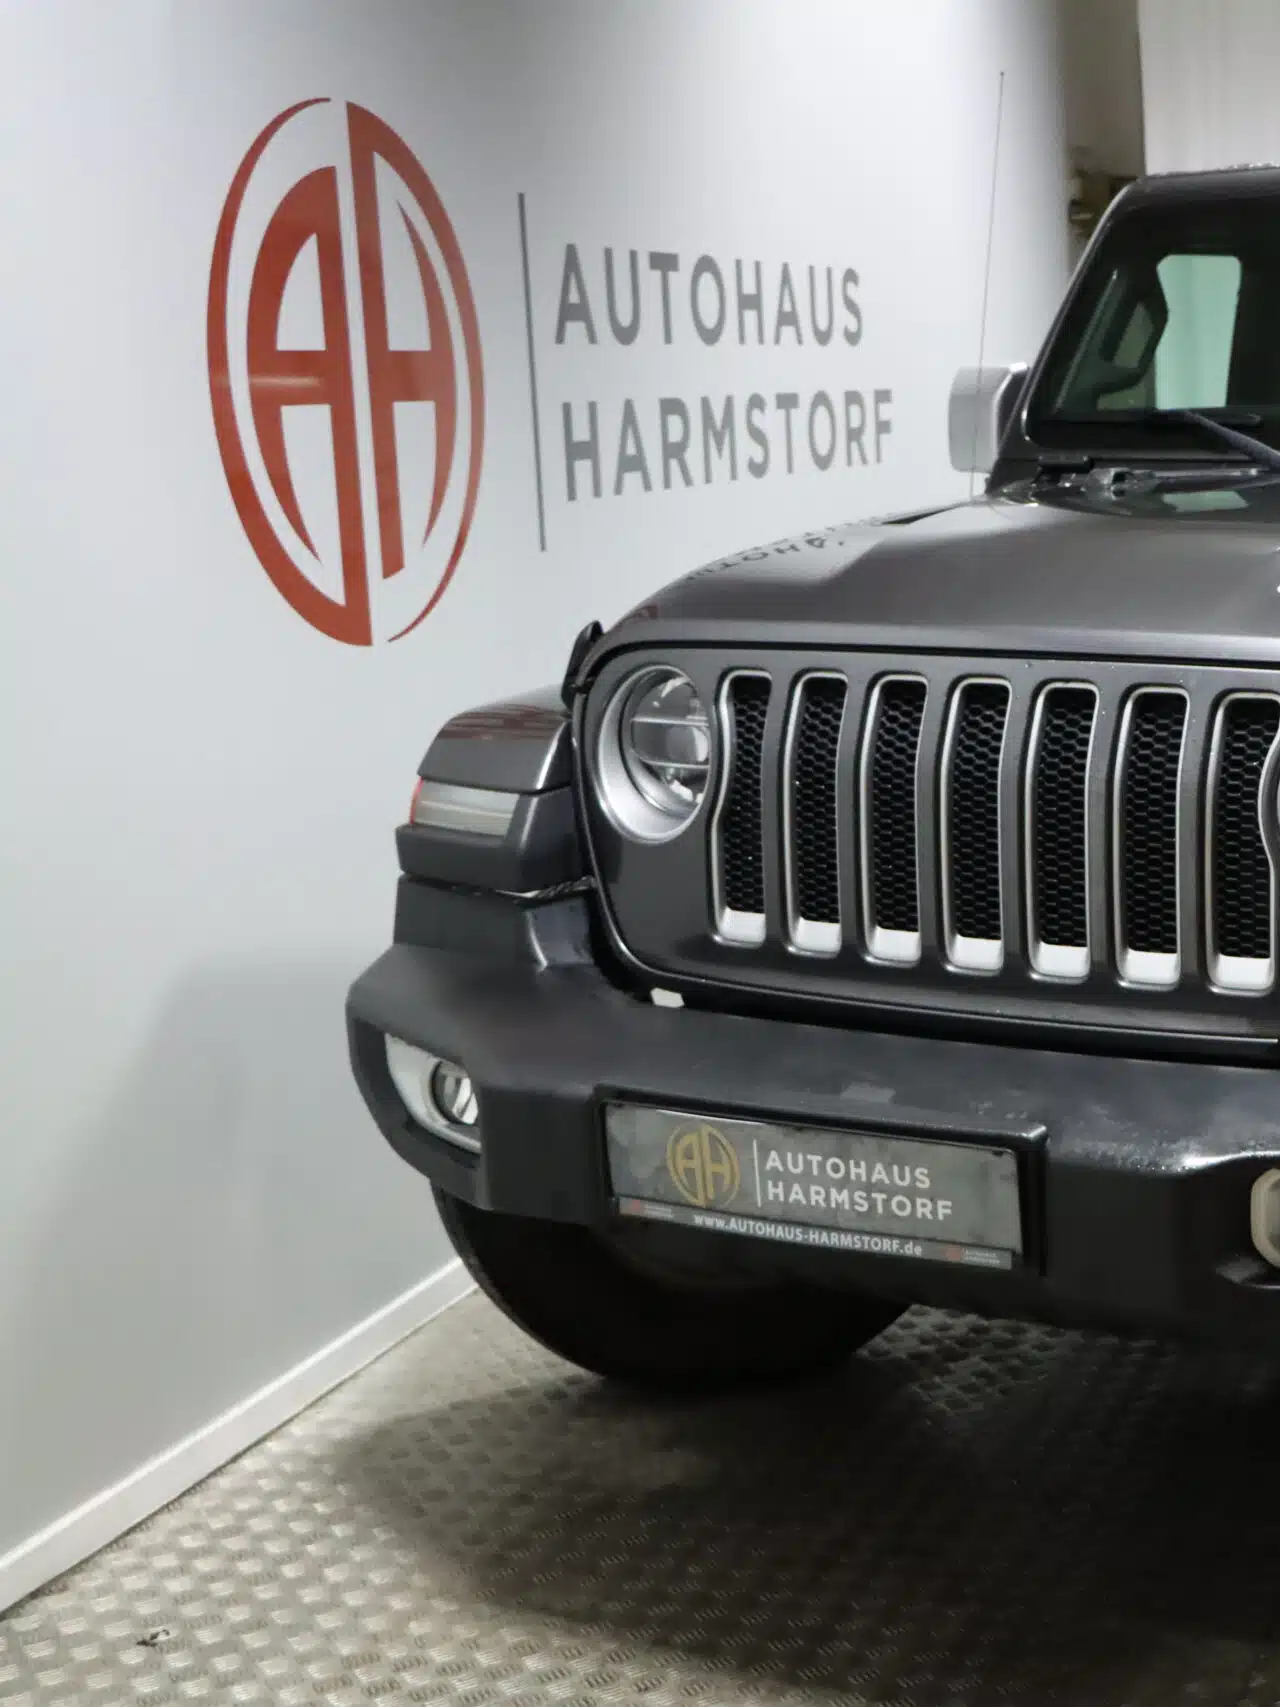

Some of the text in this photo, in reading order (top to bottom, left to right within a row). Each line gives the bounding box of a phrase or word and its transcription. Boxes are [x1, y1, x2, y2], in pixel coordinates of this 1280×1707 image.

[554, 243, 863, 347] AUTOHAUS
[561, 389, 894, 502] HARMSTORF
[765, 1150, 932, 1189] AUTOHAUS
[767, 1180, 953, 1221] HARMSTORF
[694, 1213, 924, 1258] www.AUTOHAUS-HARMSTORF.de
